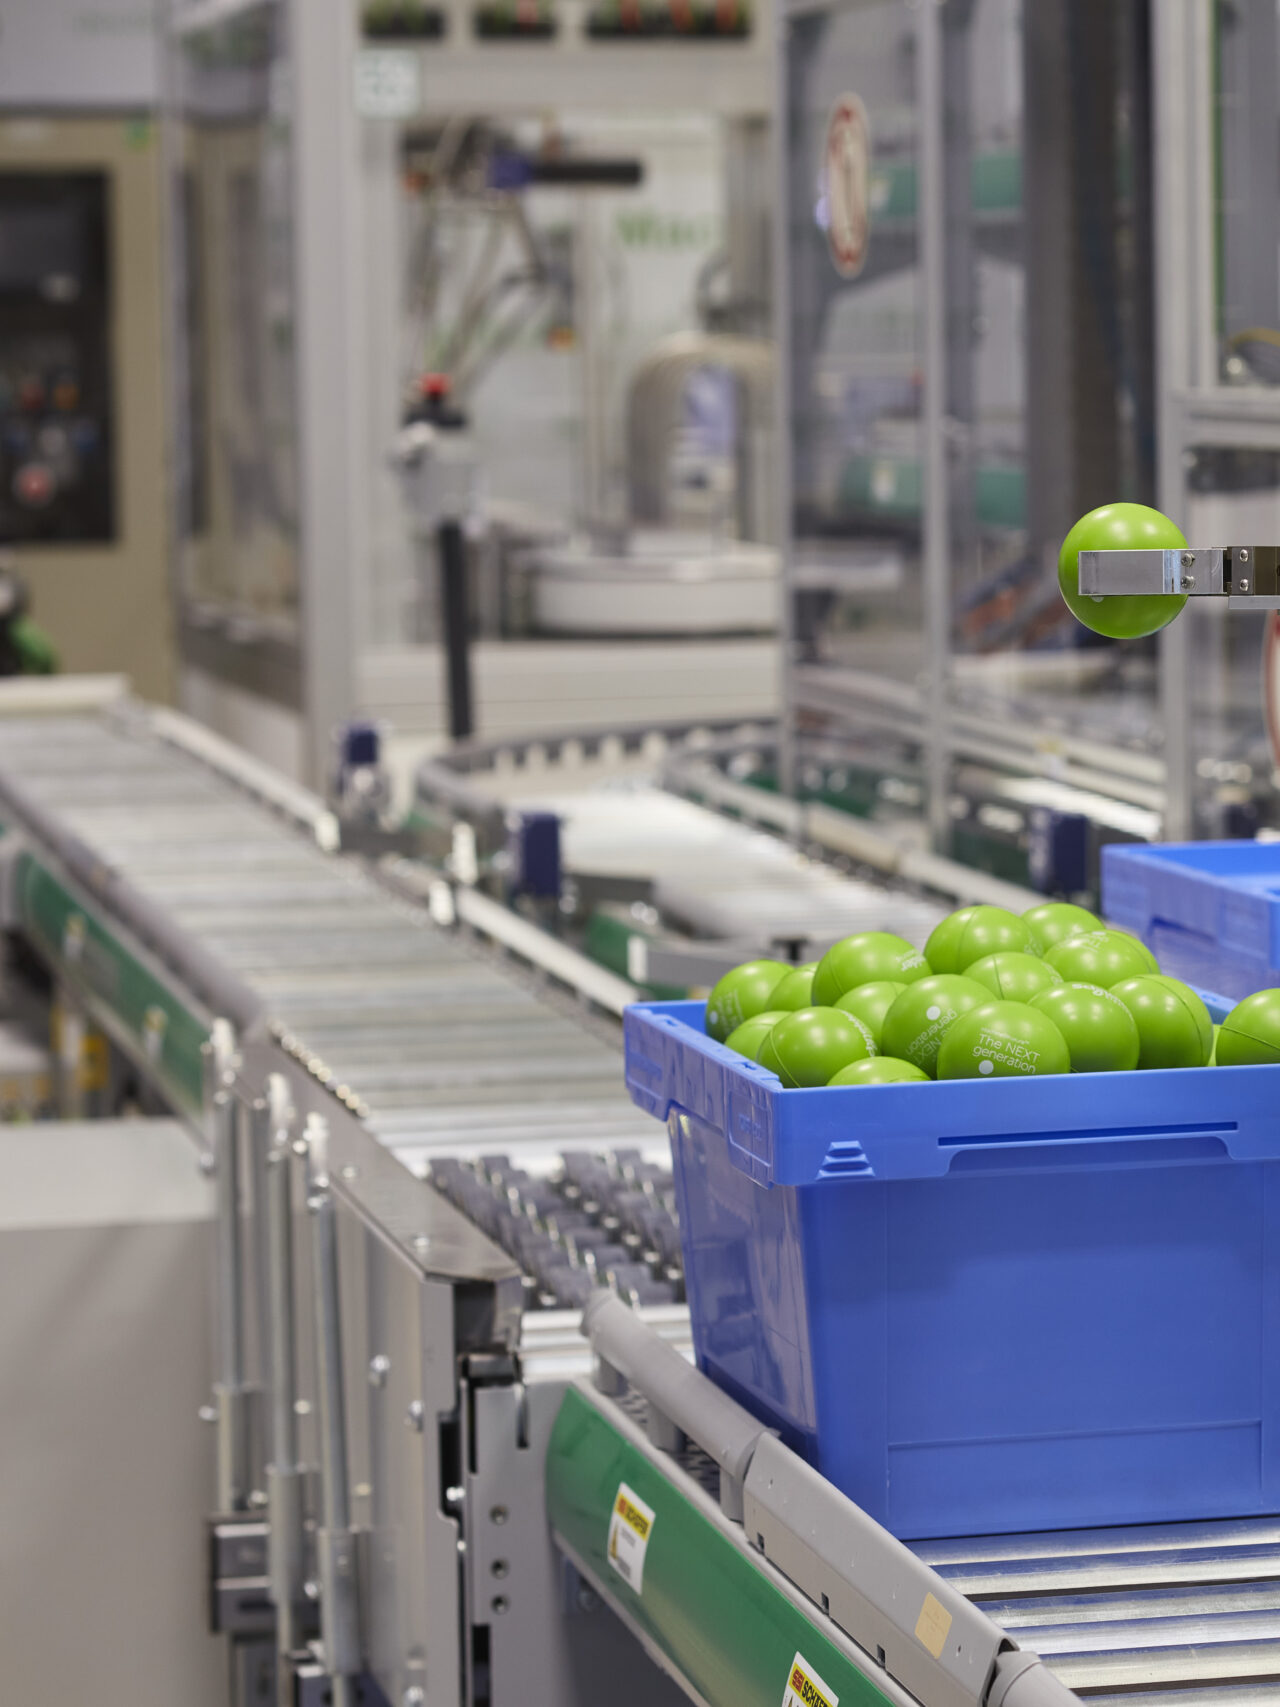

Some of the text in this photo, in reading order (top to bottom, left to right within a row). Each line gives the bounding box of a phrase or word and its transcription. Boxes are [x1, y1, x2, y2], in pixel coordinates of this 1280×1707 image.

[972, 1046, 1036, 1074] generation
[978, 1034, 1002, 1050] The
[1005, 1042, 1041, 1064] NEXT
